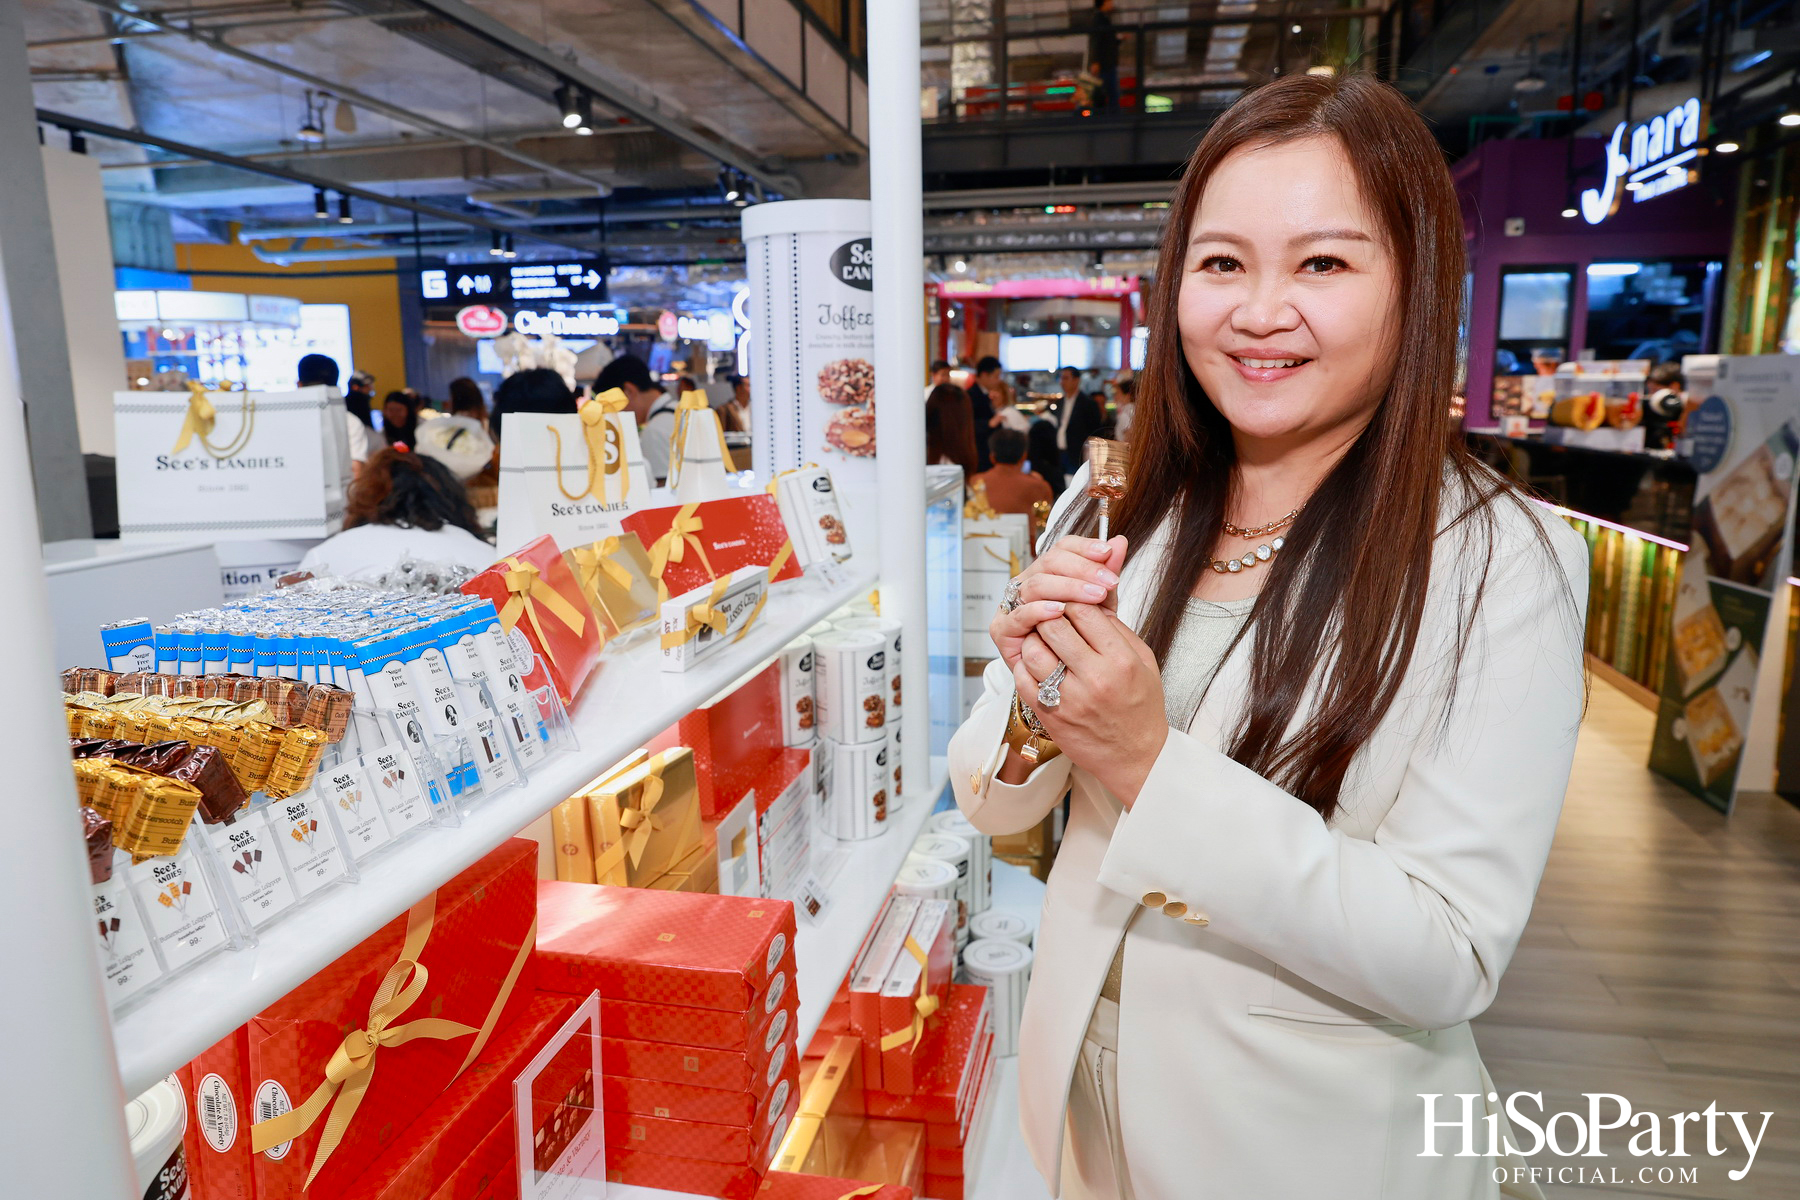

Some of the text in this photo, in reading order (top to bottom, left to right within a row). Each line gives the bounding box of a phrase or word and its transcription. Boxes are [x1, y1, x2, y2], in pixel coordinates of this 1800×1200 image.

[156, 455, 210, 471] See's
[551, 502, 582, 517] See's
[434, 686, 450, 696] See's
[397, 700, 416, 710] See's
[377, 754, 394, 765] See's
[333, 774, 351, 785] See's
[286, 802, 306, 816] See's
[229, 829, 251, 844] See's
[153, 861, 178, 878] See's
[213, 1080, 222, 1114] Chocolate
[217, 1122, 225, 1147] Variety
